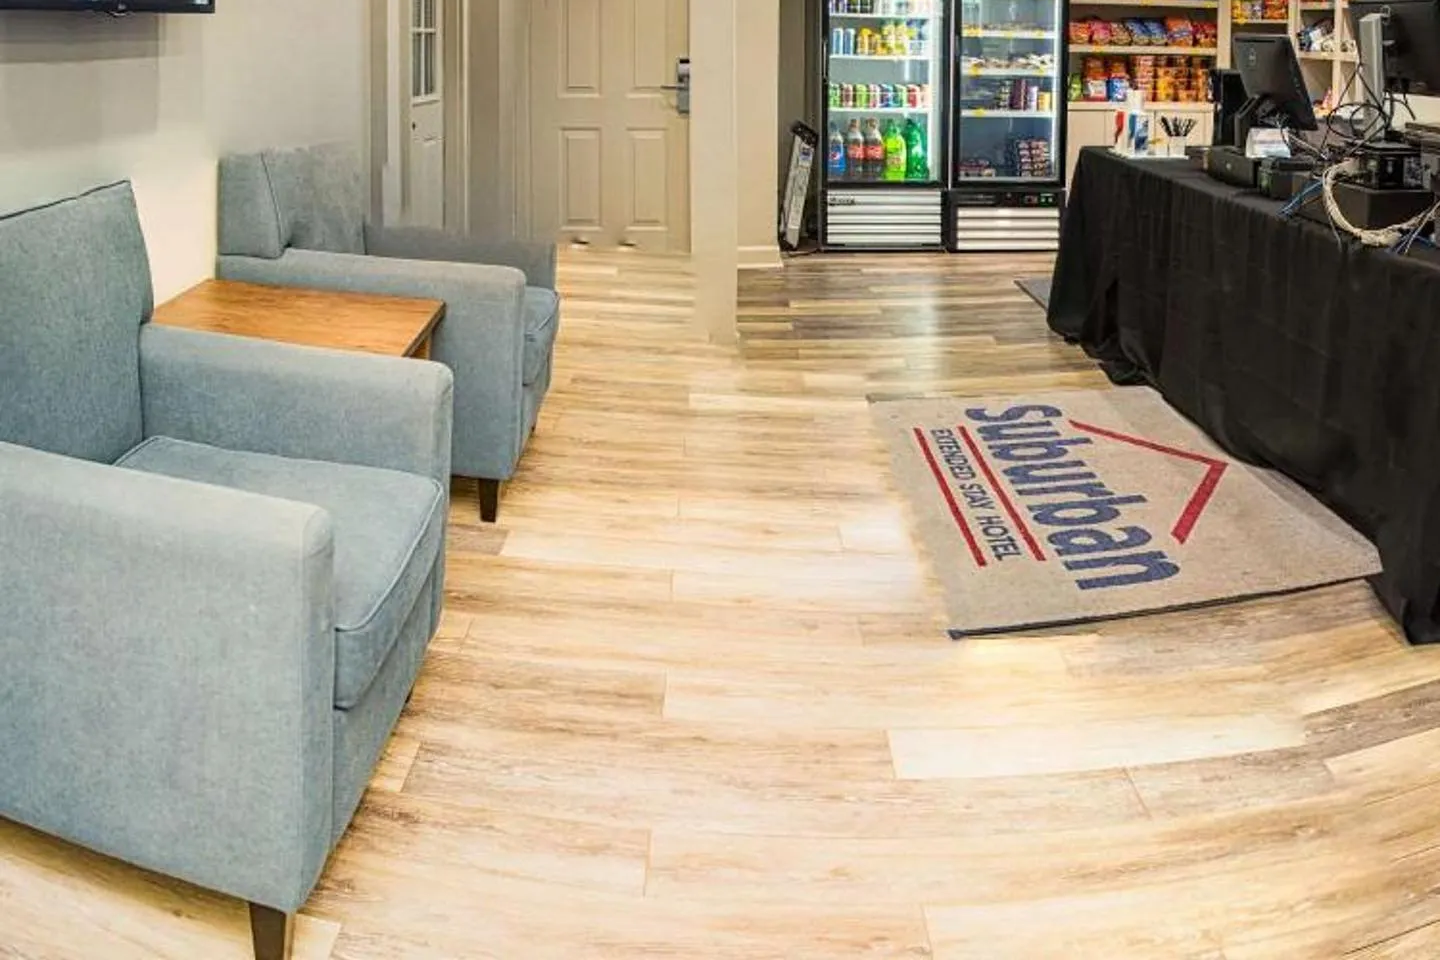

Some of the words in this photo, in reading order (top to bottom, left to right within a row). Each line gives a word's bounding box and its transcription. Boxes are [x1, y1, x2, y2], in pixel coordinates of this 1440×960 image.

[931, 428, 976, 481] EXTENDED
[959, 482, 996, 510] STAY
[975, 515, 1022, 562] HOTEL
